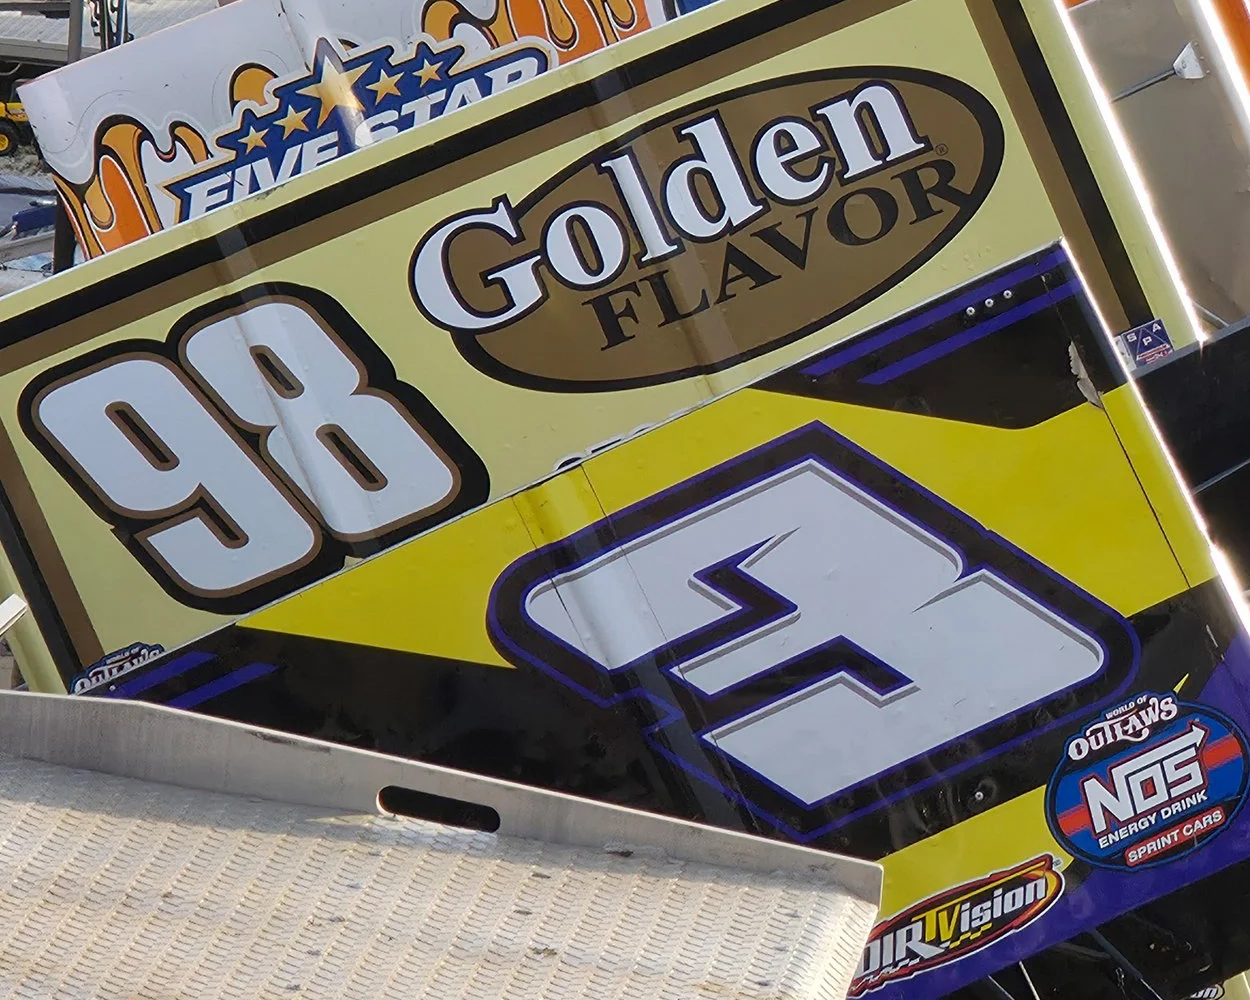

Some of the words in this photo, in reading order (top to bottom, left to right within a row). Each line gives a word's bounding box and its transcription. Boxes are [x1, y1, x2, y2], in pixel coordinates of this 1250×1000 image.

[410, 80, 932, 332] Golden
[582, 159, 976, 350] FLAVOR
[30, 293, 463, 598] 98
[508, 445, 1115, 815] 3
[1068, 697, 1178, 761] OUTLAWS
[1105, 701, 1136, 720] WORLD
[1137, 695, 1148, 705] OF
[1083, 724, 1206, 835] NOS
[1098, 811, 1157, 850] ENERGY
[1160, 789, 1208, 820] DRINK
[1127, 829, 1180, 864] SPRINT
[1182, 810, 1224, 837] CARS
